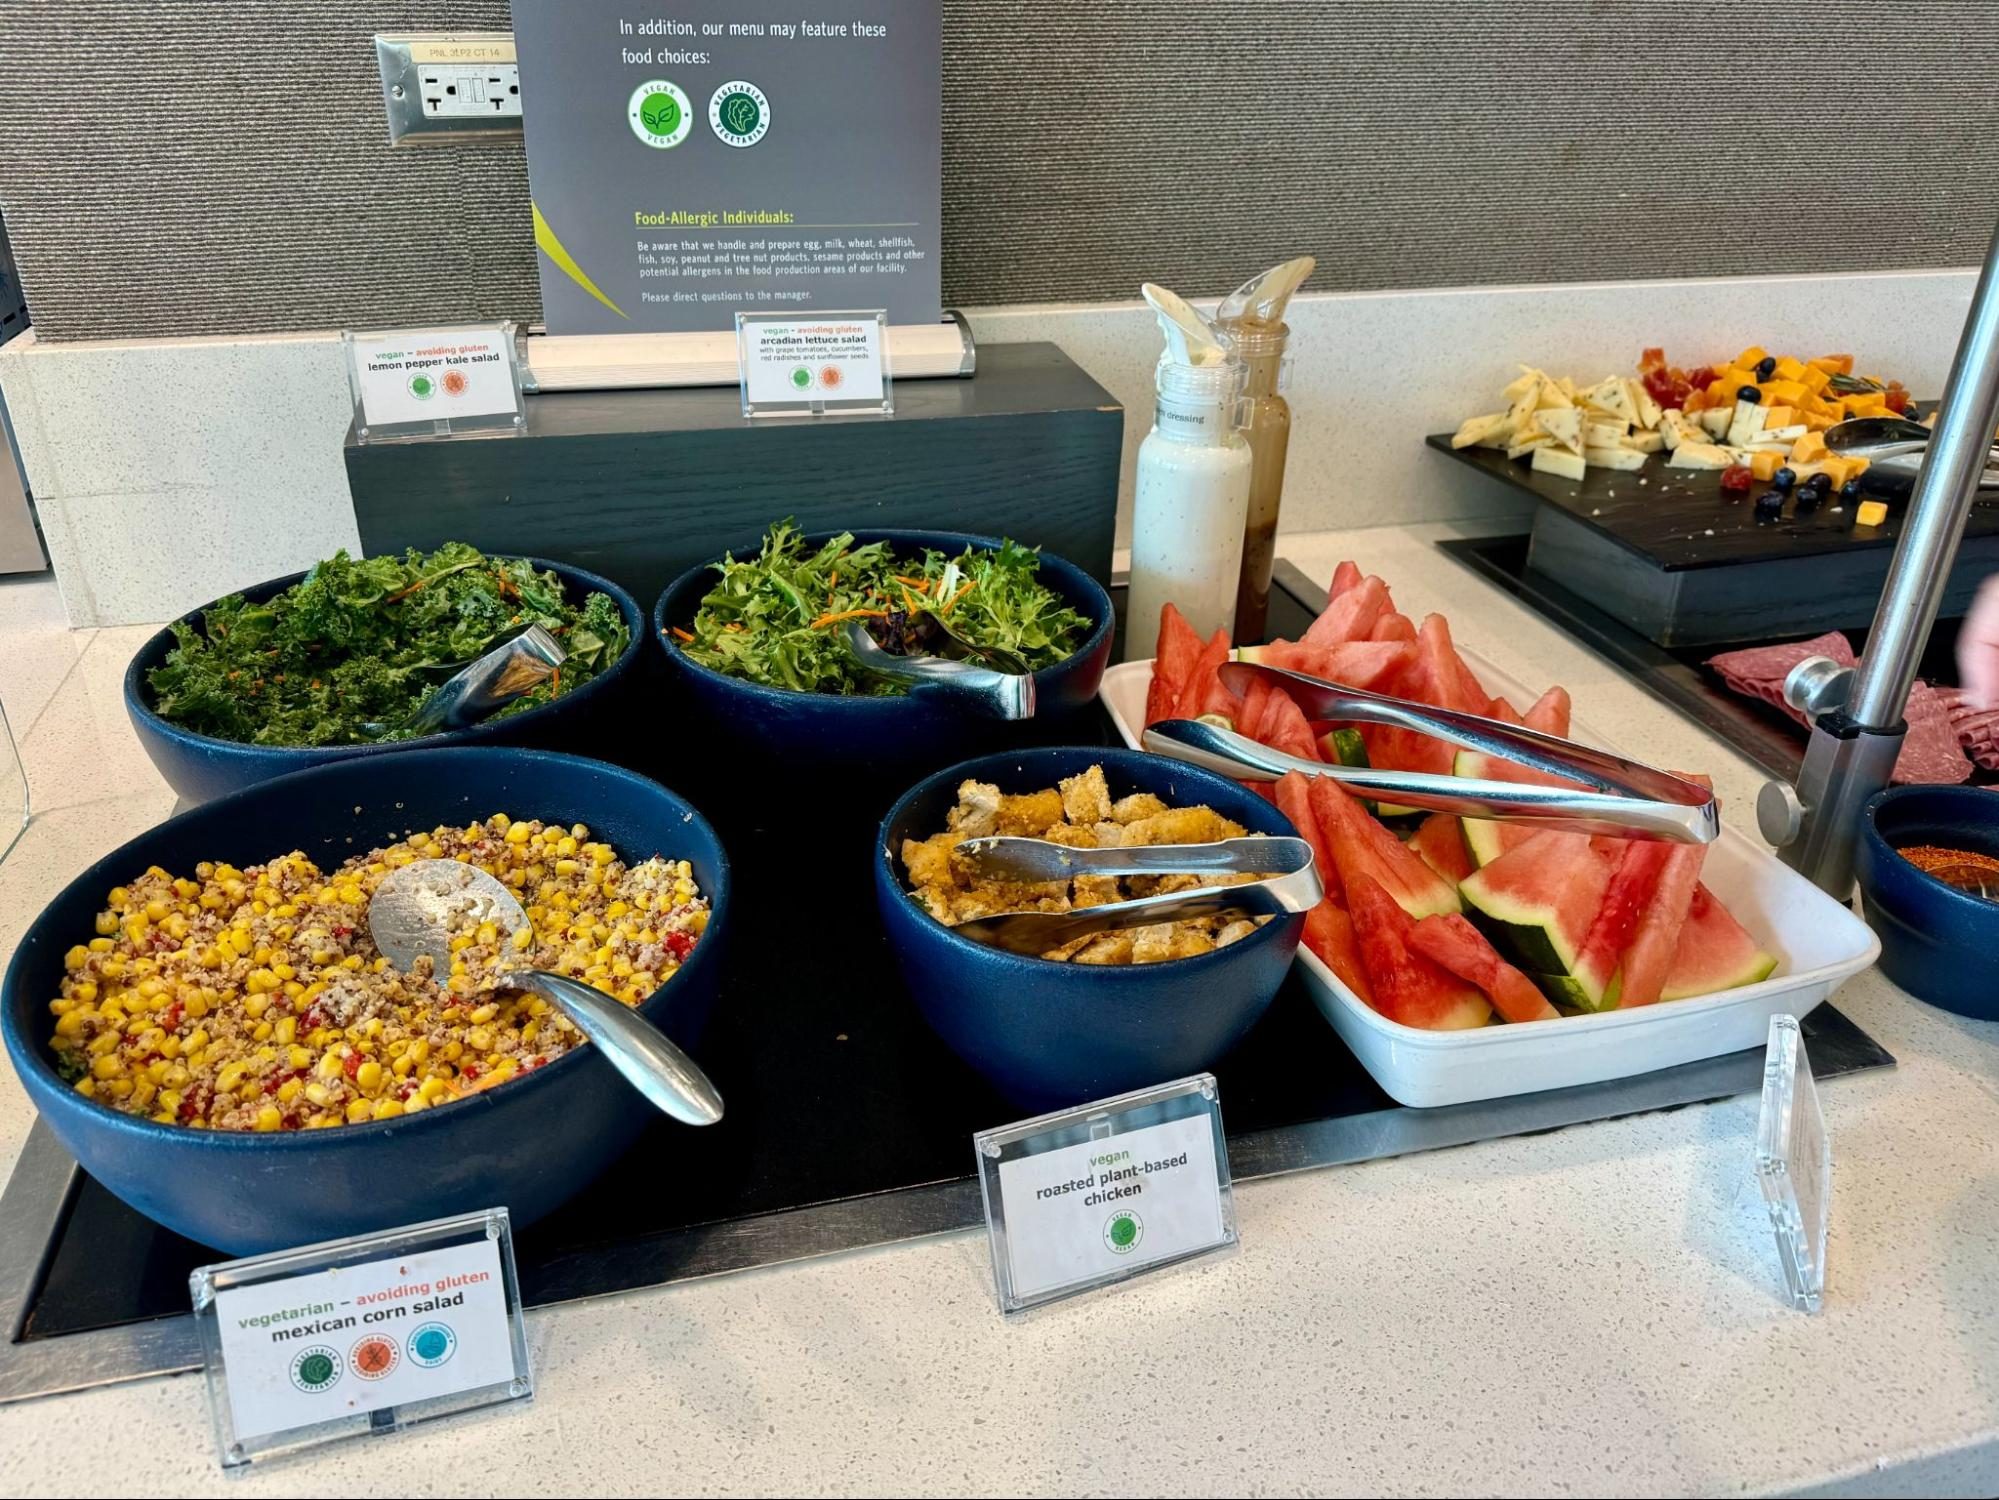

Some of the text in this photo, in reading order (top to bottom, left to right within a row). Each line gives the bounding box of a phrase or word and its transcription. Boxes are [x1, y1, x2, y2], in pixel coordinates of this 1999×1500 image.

[620, 19, 887, 39] In addition, our menu may feature these
[622, 48, 710, 64] food choices:
[643, 84, 676, 95] VEGAN
[714, 84, 765, 106] VEGETARIAN
[647, 133, 679, 144] VEGAN
[715, 122, 766, 144] VEGETARIAN
[635, 209, 793, 227] Food-Allergic Individuals:
[637, 241, 649, 251] Be
[652, 242, 678, 251] aware
[681, 241, 699, 250] that
[702, 242, 715, 250] we
[718, 240, 746, 250] handle
[750, 240, 765, 250] and
[768, 241, 801, 251] prepare
[803, 241, 822, 251] egg,
[878, 237, 915, 248] shellfish,
[638, 254, 658, 264] fish,
[661, 255, 679, 264] soy,
[681, 254, 711, 265] peanut
[714, 253, 730, 263] and
[733, 253, 752, 263] tree
[753, 253, 767, 263] nut
[813, 252, 844, 262] sesame
[846, 251, 883, 263] products
[886, 250, 901, 260] and
[903, 250, 925, 260] other
[640, 262, 907, 278] potential allergens in the food production areas of our facility.
[642, 290, 812, 303] Please direct questions to the manager.
[763, 328, 789, 336] vegan
[797, 326, 834, 335] avoiding
[835, 326, 863, 335] gluten
[760, 335, 867, 345] arcadian lettuce salad
[376, 351, 404, 360] vegan
[416, 344, 457, 357] avoiding
[459, 343, 489, 354] gluten
[760, 346, 774, 354] with
[775, 346, 795, 355] grape
[760, 352, 869, 361] red radishes and sunflower seeds
[368, 353, 500, 371] lemon pepper kale salad
[1167, 411, 1205, 424] dressing
[1089, 1150, 1130, 1167] vegan
[1036, 1152, 1188, 1200] roasted plant-based
[1084, 1183, 1142, 1207] chicken
[238, 1300, 334, 1330] vegetarian
[356, 1282, 430, 1306] avoiding
[436, 1270, 490, 1293] gluten
[272, 1292, 465, 1342] mexican corn salad
